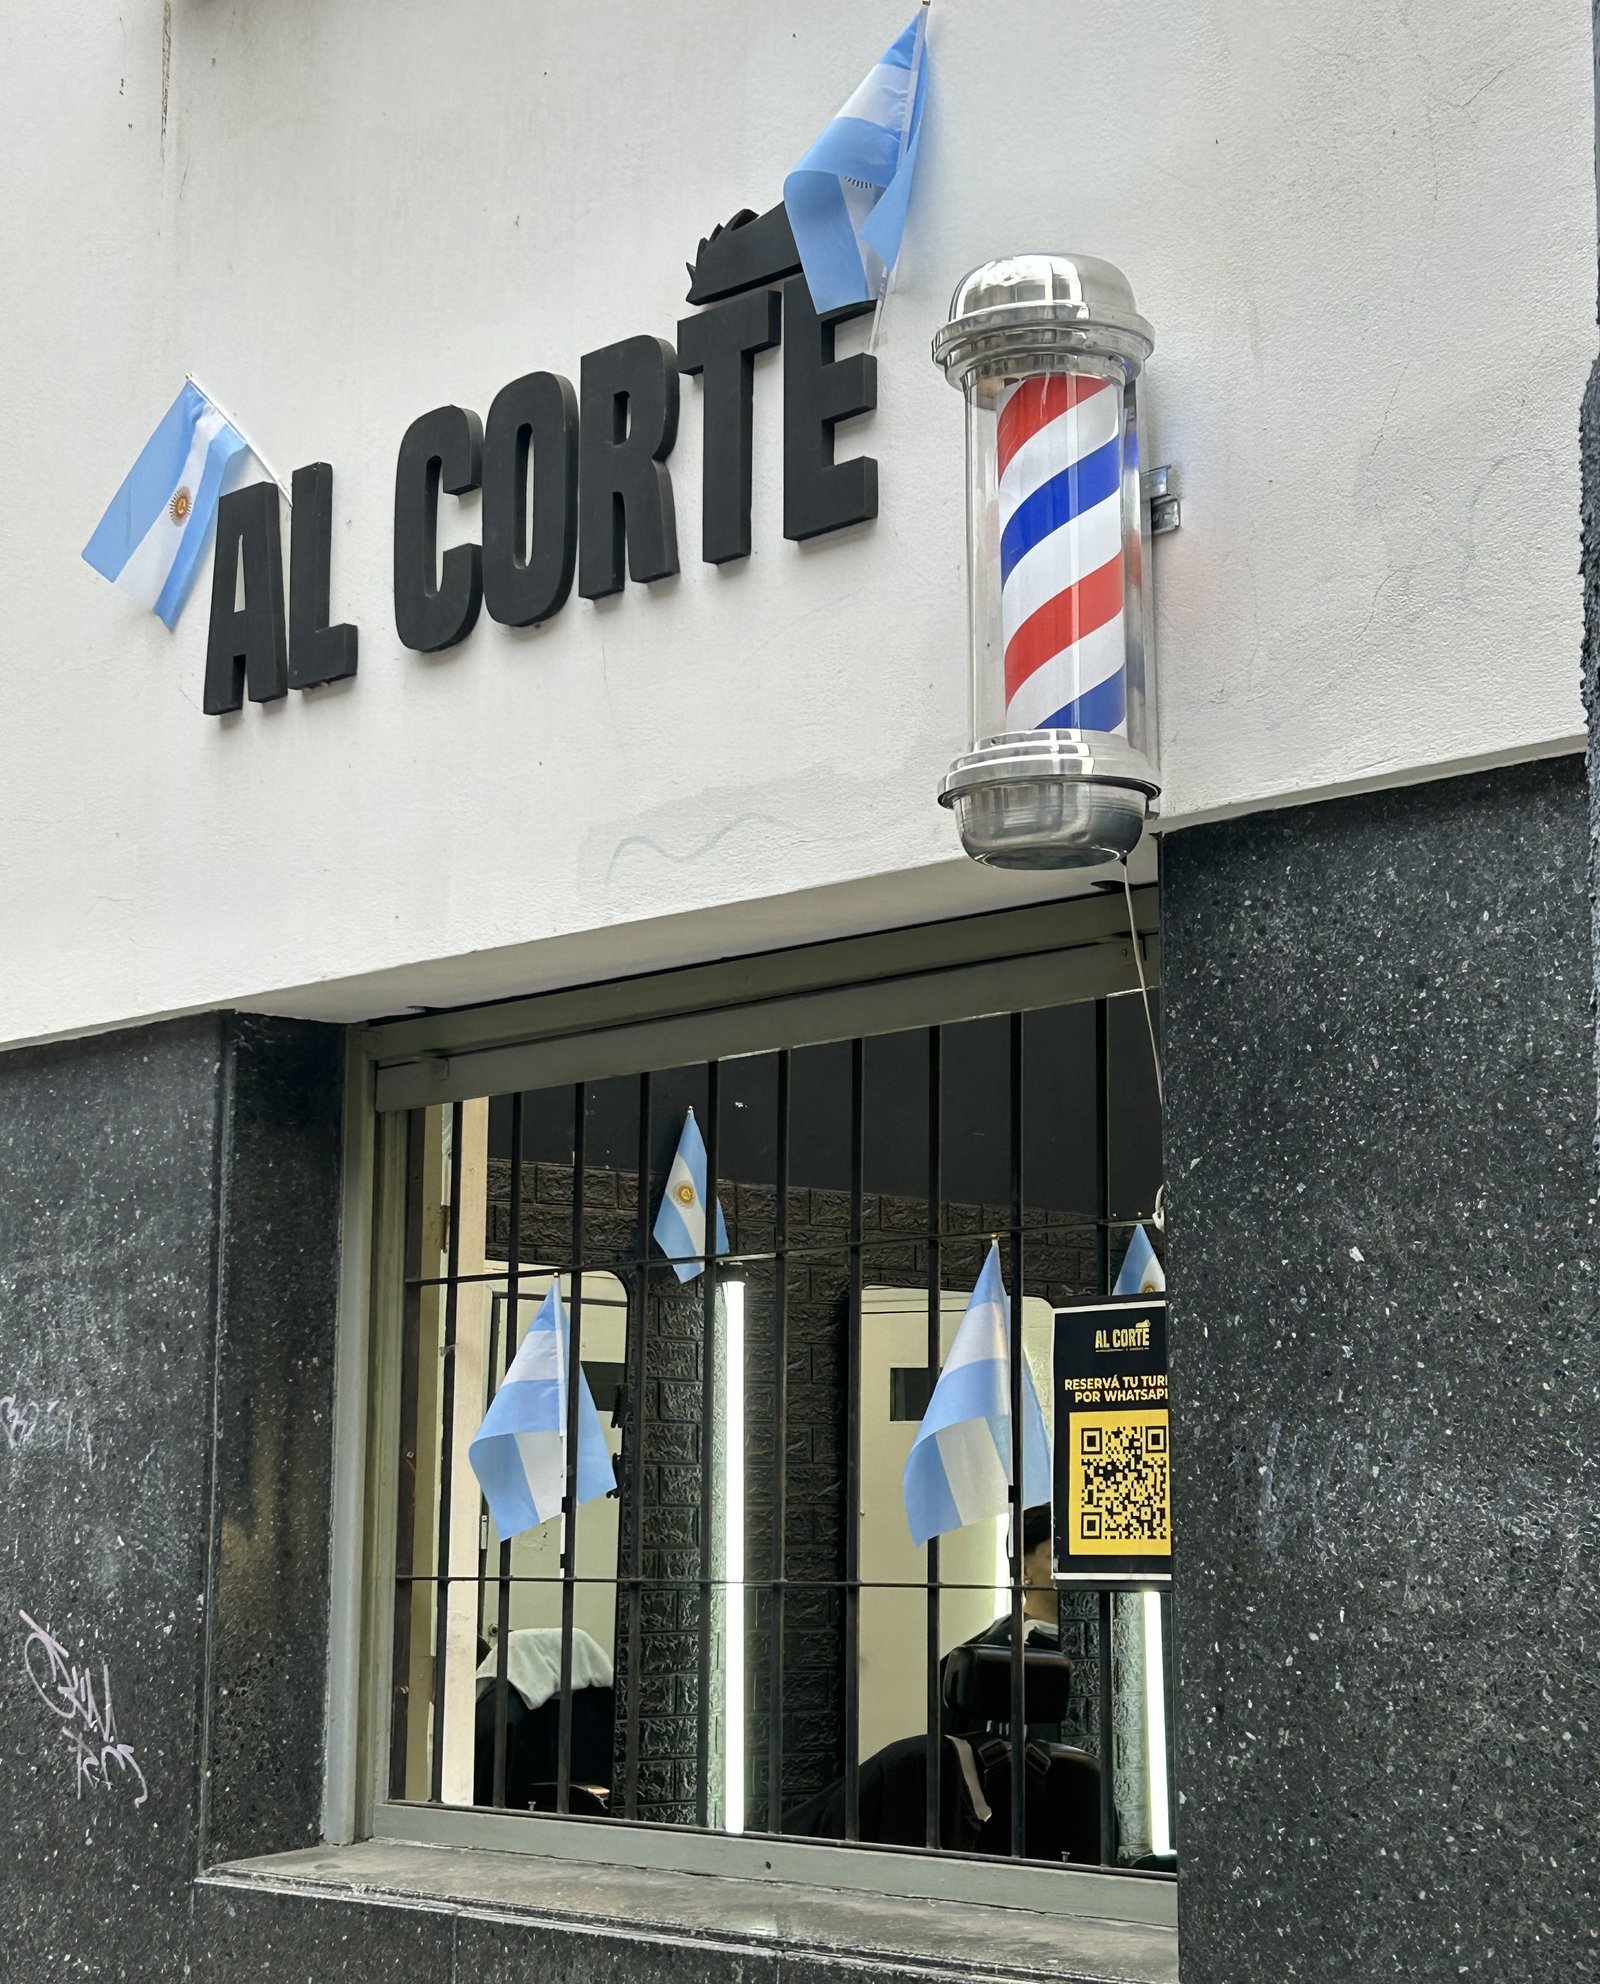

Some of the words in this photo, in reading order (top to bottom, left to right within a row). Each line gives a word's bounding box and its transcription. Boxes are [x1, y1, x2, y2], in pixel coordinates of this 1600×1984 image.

[203, 461, 358, 716] AL
[1095, 1329, 1110, 1349] AL
[1064, 1373, 1120, 1391] RESERVÁ
[1122, 1376, 1139, 1388] TU
[1140, 1374, 1168, 1387] TUR
[1074, 1391, 1101, 1403] POR
